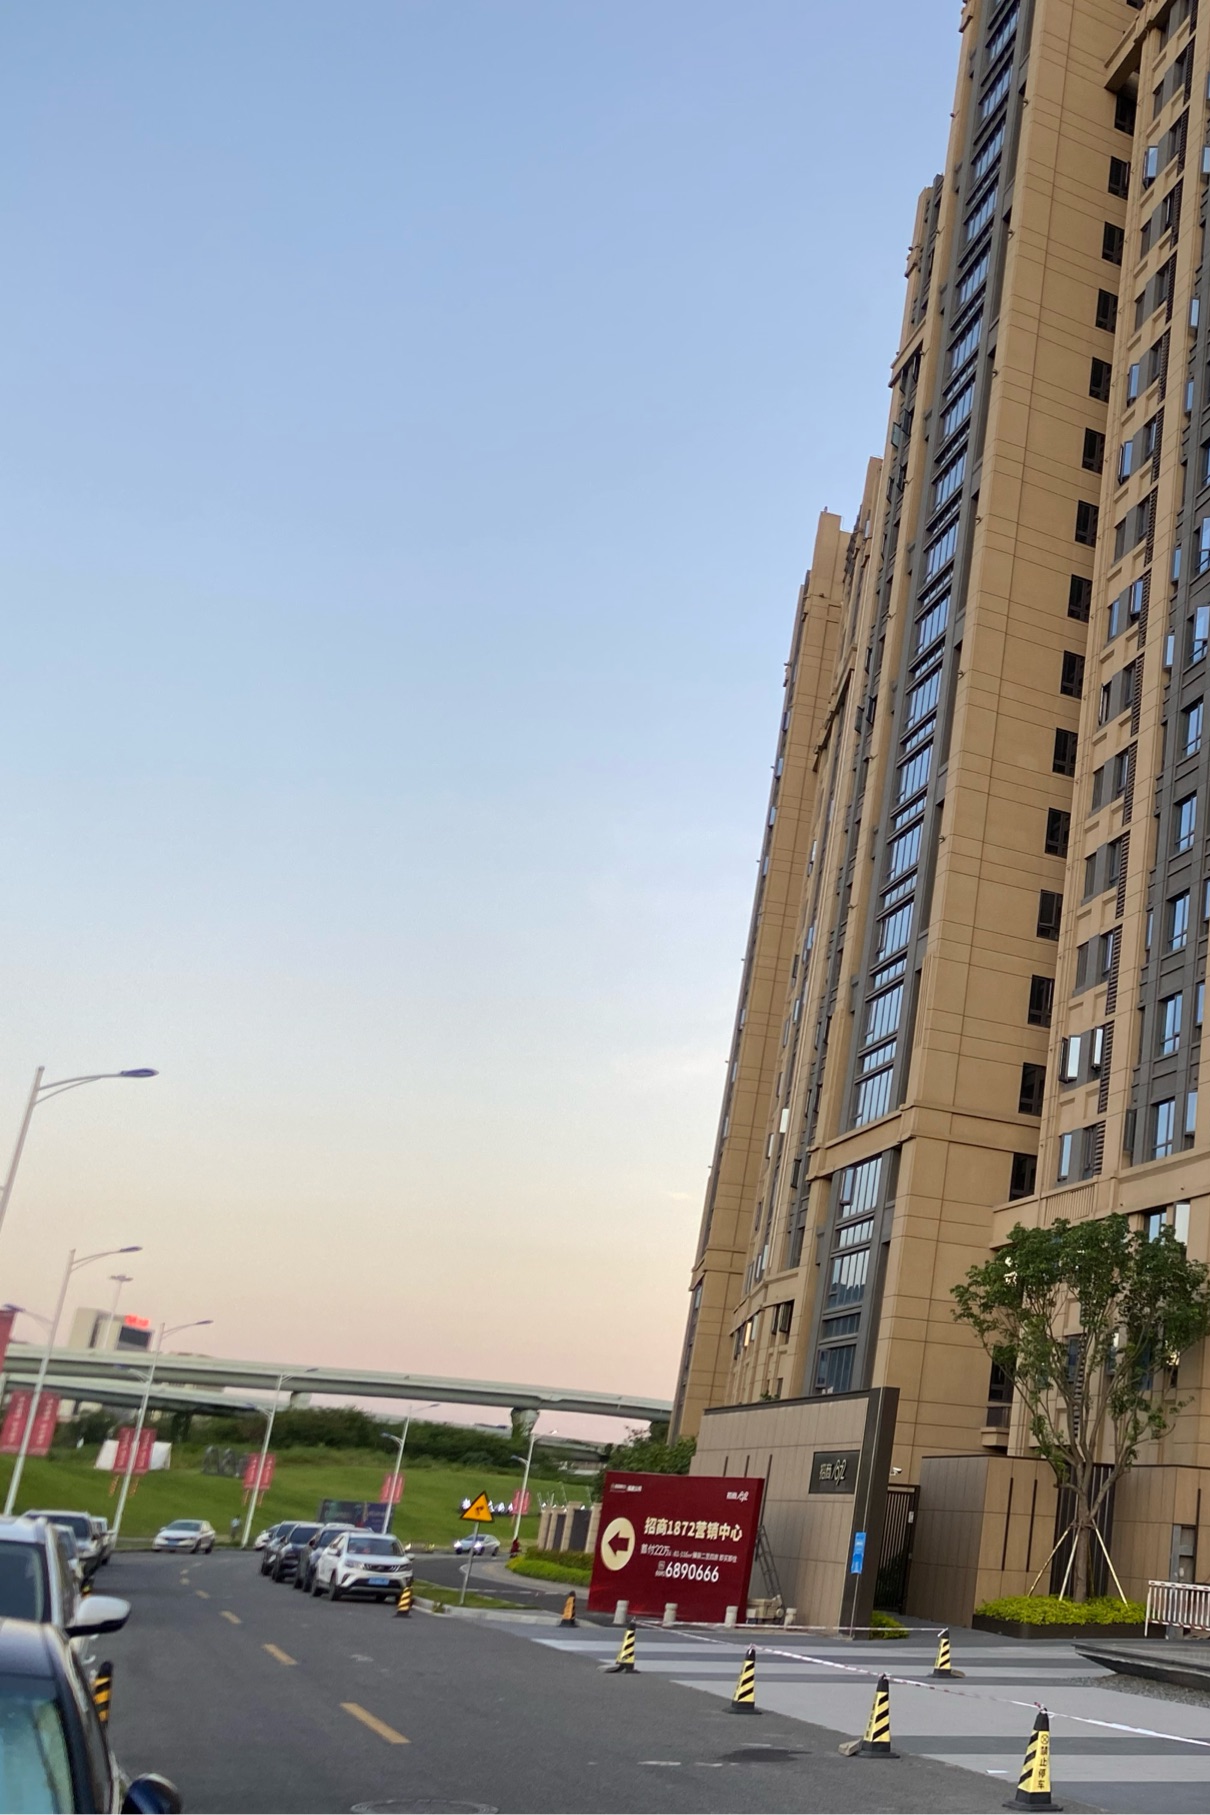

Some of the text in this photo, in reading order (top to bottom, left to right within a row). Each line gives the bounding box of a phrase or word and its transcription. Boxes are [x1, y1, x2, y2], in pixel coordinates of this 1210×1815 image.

[644, 1517, 743, 1541] 招商1872营销中心
[665, 1561, 720, 1583] 6890666
